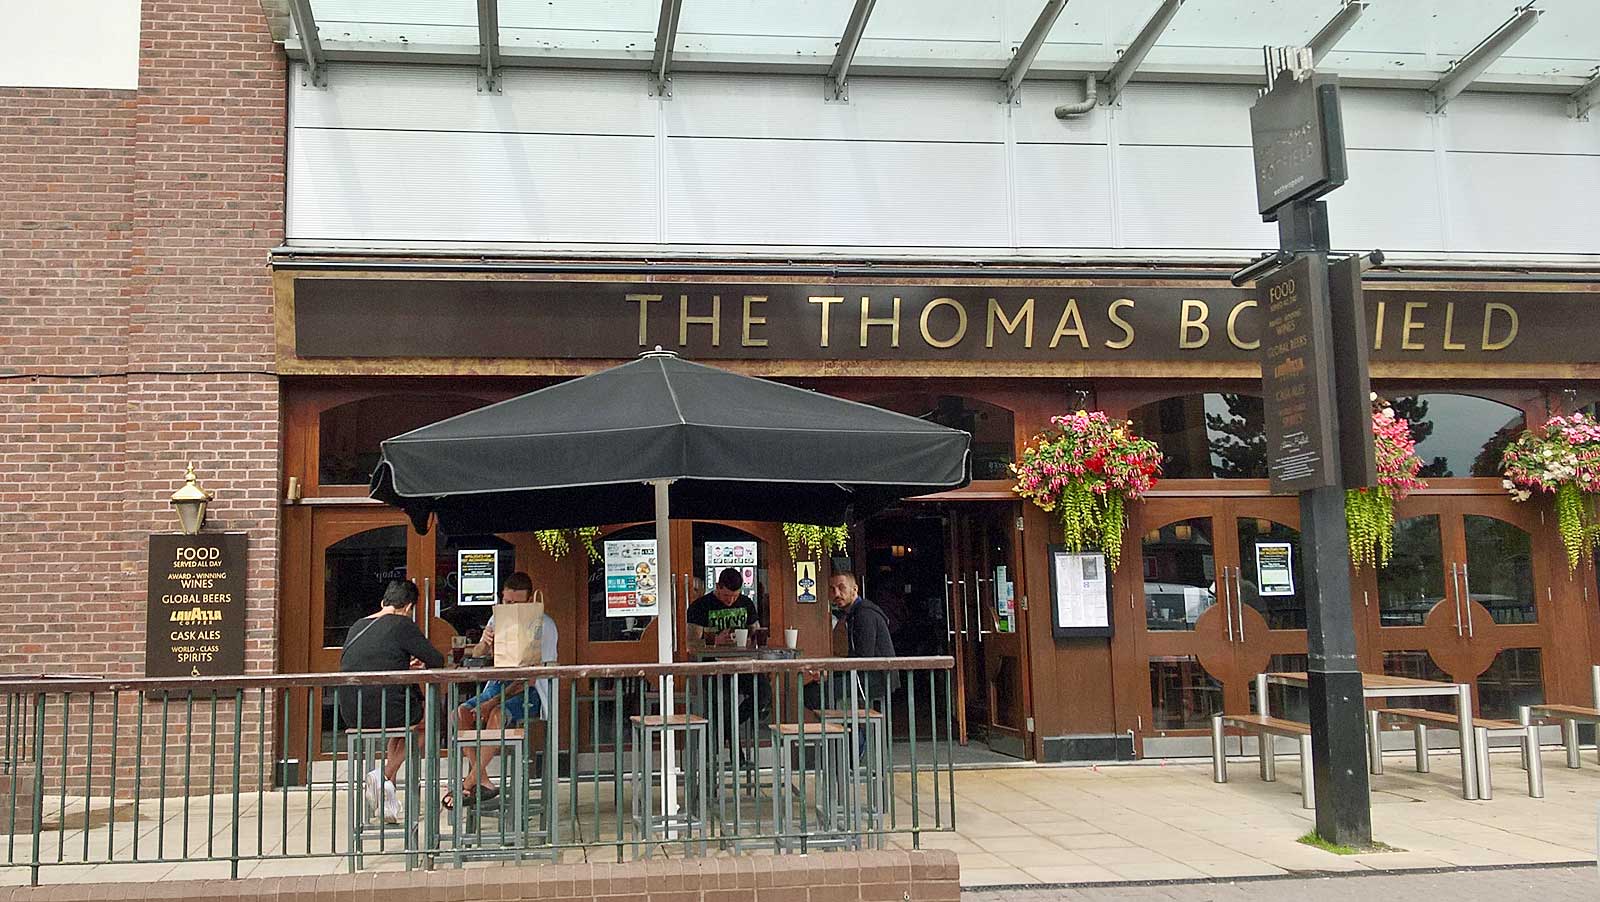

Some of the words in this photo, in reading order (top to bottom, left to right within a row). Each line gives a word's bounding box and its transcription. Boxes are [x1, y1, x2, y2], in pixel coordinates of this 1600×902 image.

[1270, 279, 1295, 303] FOOD
[625, 294, 768, 347] THE
[808, 296, 1135, 350] THOMAS
[1179, 299, 1519, 351] BOIELD
[176, 547, 220, 560] FOOD
[173, 560, 197, 568] SERVED
[197, 560, 208, 568] ALL
[181, 580, 213, 589] WINES
[162, 594, 200, 604] GLOBAL
[202, 593, 232, 603] BEERS
[169, 607, 222, 622] LAVAZZA
[170, 632, 196, 641] CASK
[198, 631, 221, 640] ALES
[200, 645, 219, 653] CLASS
[178, 653, 213, 663] SPIRITS
